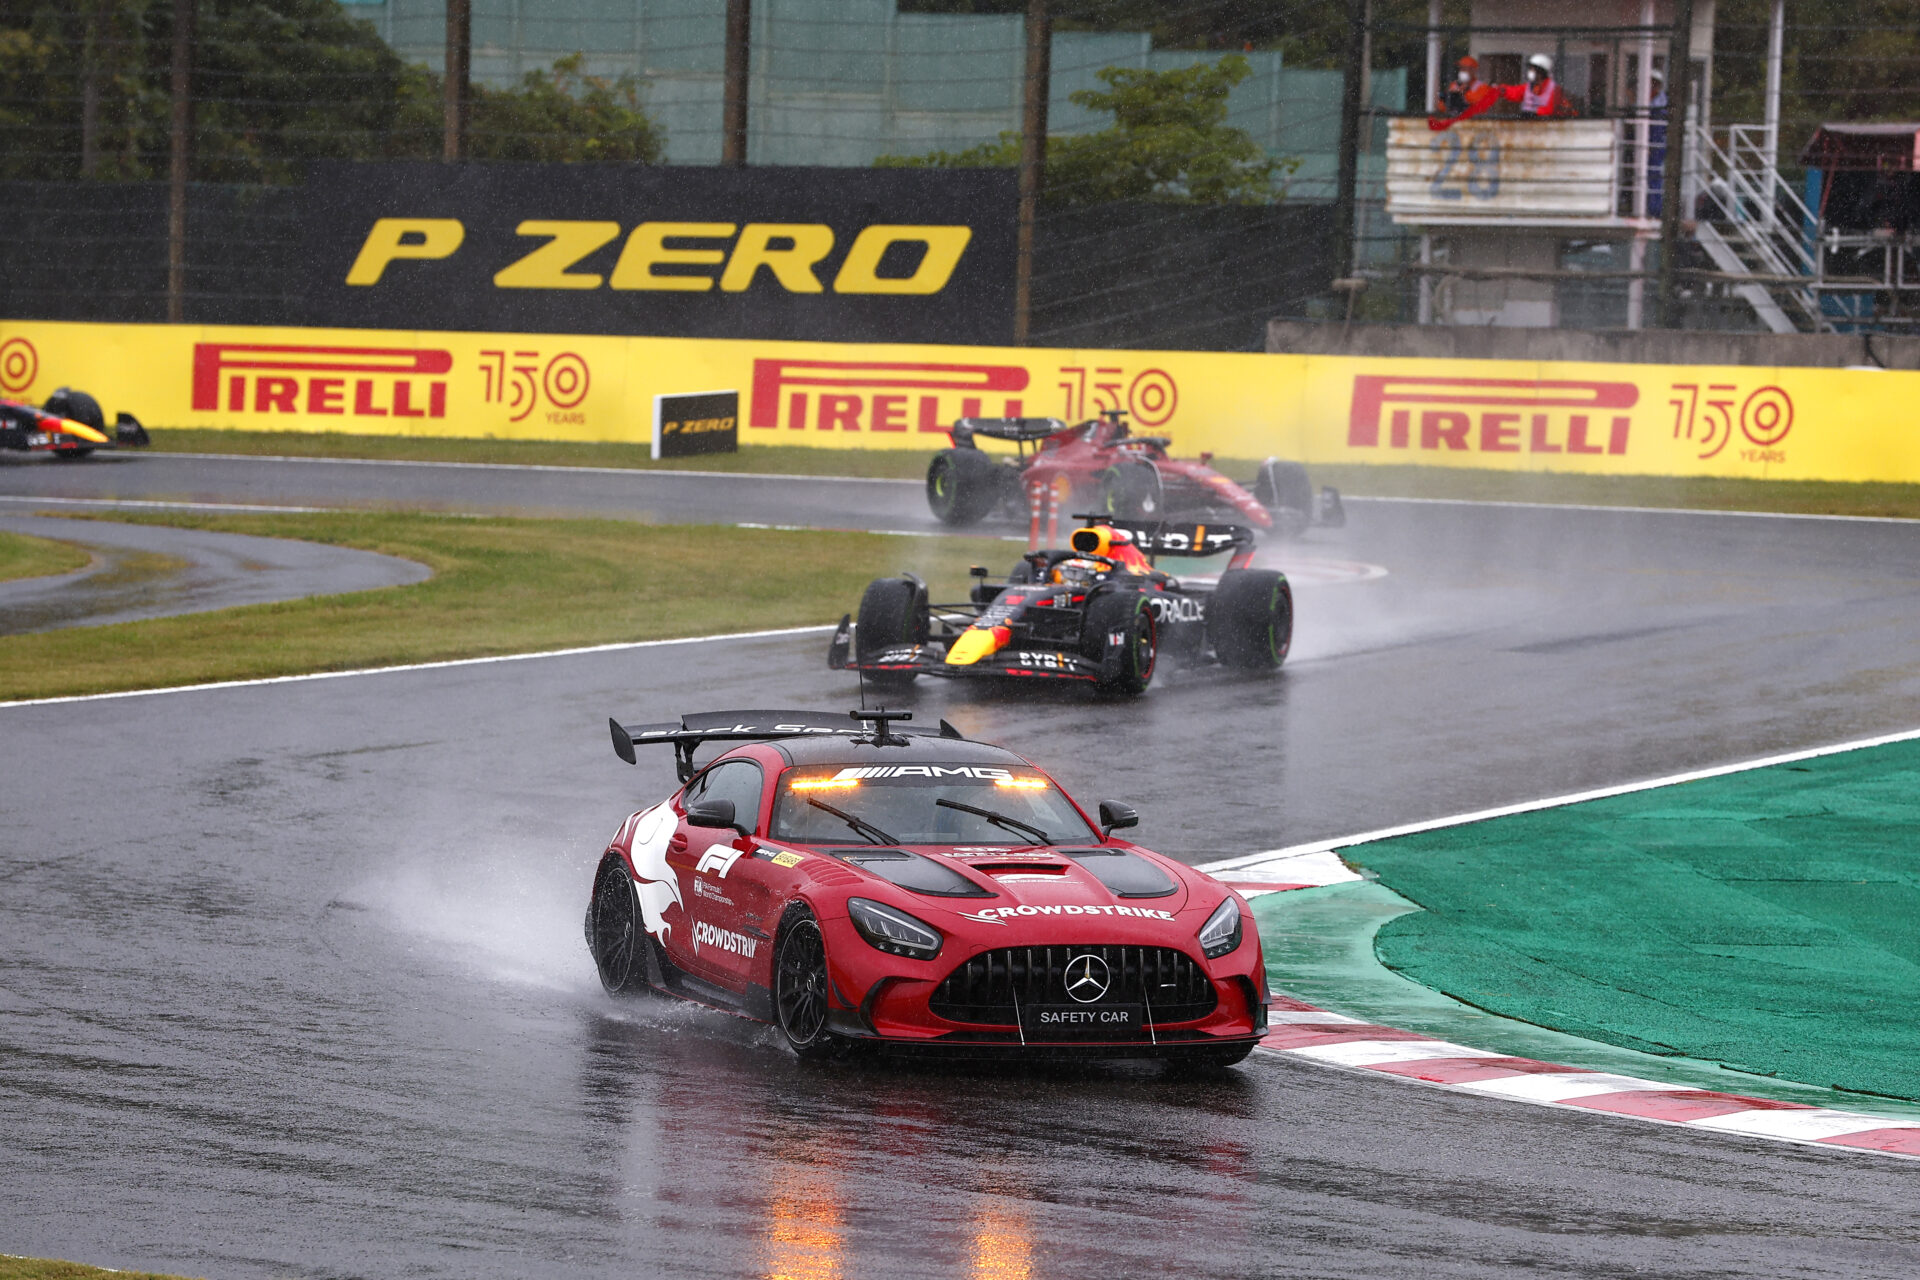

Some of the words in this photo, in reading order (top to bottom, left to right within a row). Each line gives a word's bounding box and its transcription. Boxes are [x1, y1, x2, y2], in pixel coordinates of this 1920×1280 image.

[1429, 130, 1500, 200] 28
[344, 217, 465, 286] P
[492, 219, 973, 295] ZERO
[191, 343, 453, 418] PIRELLI
[478, 350, 590, 422] 150
[546, 412, 585, 424] YEARS
[1347, 374, 1640, 455] PIRELLI
[1668, 384, 1794, 459] 150
[662, 421, 679, 435] P
[680, 417, 735, 434] ZERO
[1740, 449, 1786, 464] YEARS
[1019, 652, 1079, 671] BYBIT
[890, 766, 1014, 780] AMG
[977, 904, 1176, 922] CROWDSTRIKE
[1040, 1011, 1096, 1024] SAFETY
[1100, 1011, 1129, 1023] CAR
